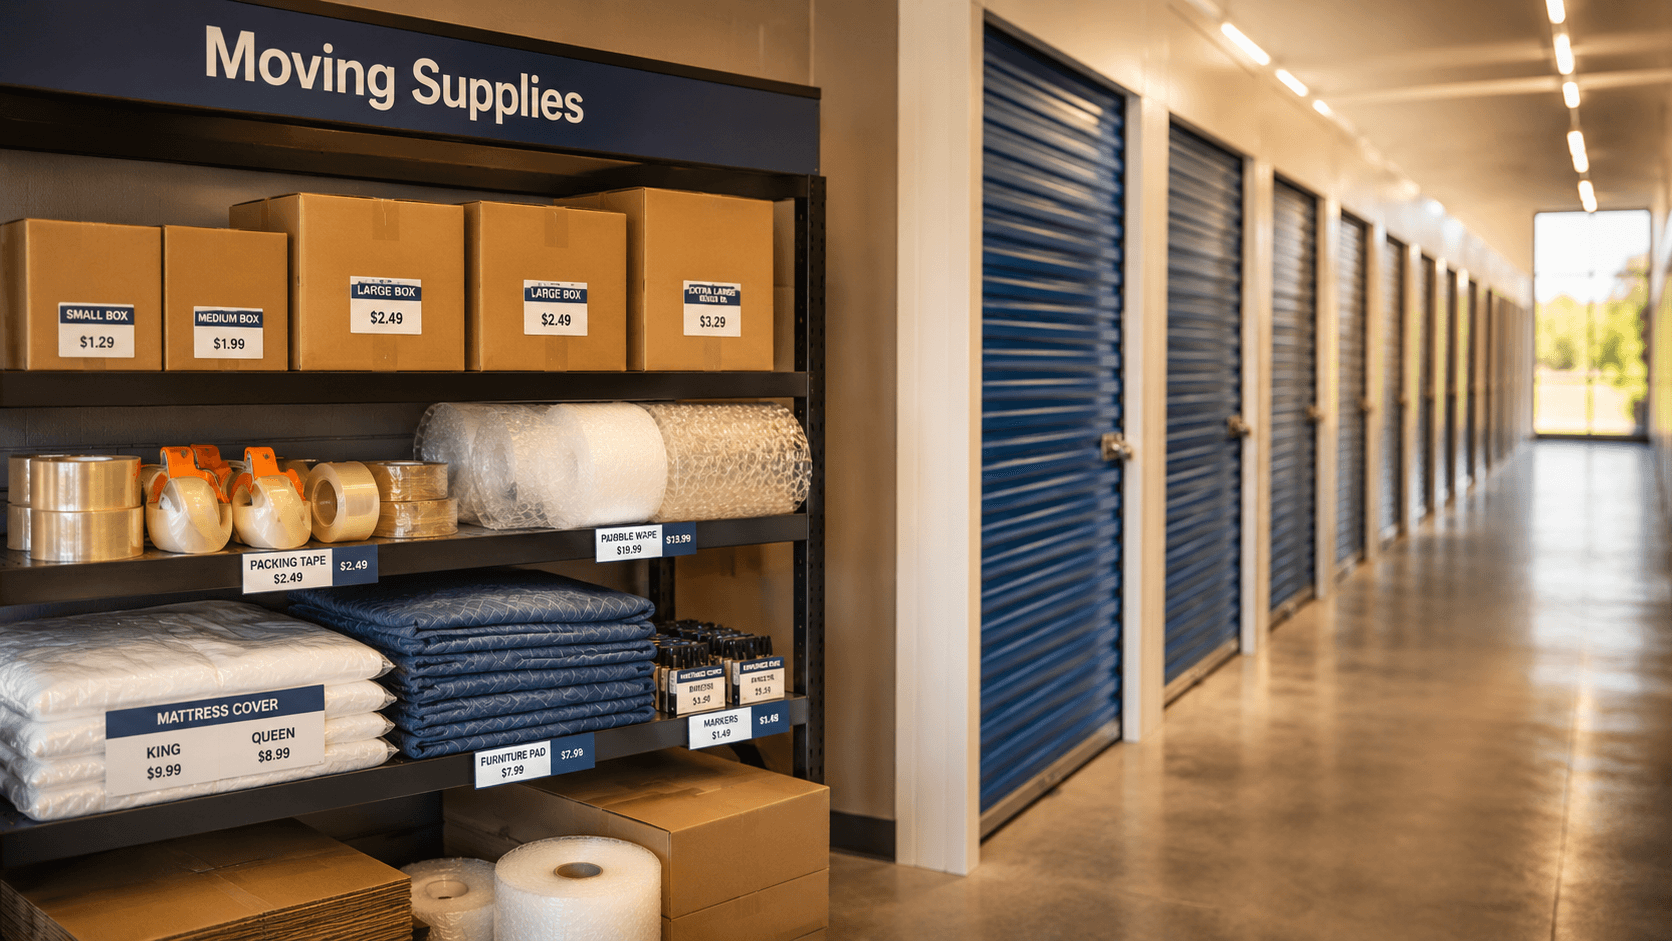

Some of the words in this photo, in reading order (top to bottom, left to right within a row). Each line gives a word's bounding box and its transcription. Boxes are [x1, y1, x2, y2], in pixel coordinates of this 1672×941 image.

[205, 24, 395, 111] Moving
[411, 57, 584, 124] Supplies
[357, 284, 392, 296] LARGE
[394, 286, 416, 297] BOX
[531, 287, 561, 299] LARGE
[563, 289, 581, 300] BOX
[66, 309, 103, 321] SMALL
[106, 310, 128, 321] BOX
[198, 313, 238, 324] MEDIUM
[239, 314, 260, 325] BOX
[370, 310, 403, 325] $2.49
[541, 313, 571, 327] $2.49
[700, 315, 726, 328] $3.29
[80, 335, 114, 350] $1.29
[213, 337, 245, 351] $1.99
[617, 544, 642, 555] $19.99
[250, 557, 297, 571] PACKING
[299, 555, 326, 567] TAPE
[340, 559, 368, 572] $2.49
[274, 572, 303, 585] $2.49
[157, 704, 229, 725] MATTRESS
[232, 698, 278, 715] COVER
[703, 714, 739, 728] MARKERS
[251, 727, 295, 745] QUEEN
[711, 728, 731, 740] $1.49
[146, 743, 181, 759] KING
[258, 747, 290, 763] $8.99
[480, 750, 528, 767] FURNITURE
[529, 747, 546, 759] PAD
[147, 763, 182, 781] $9.99
[501, 765, 525, 779] $7.99
